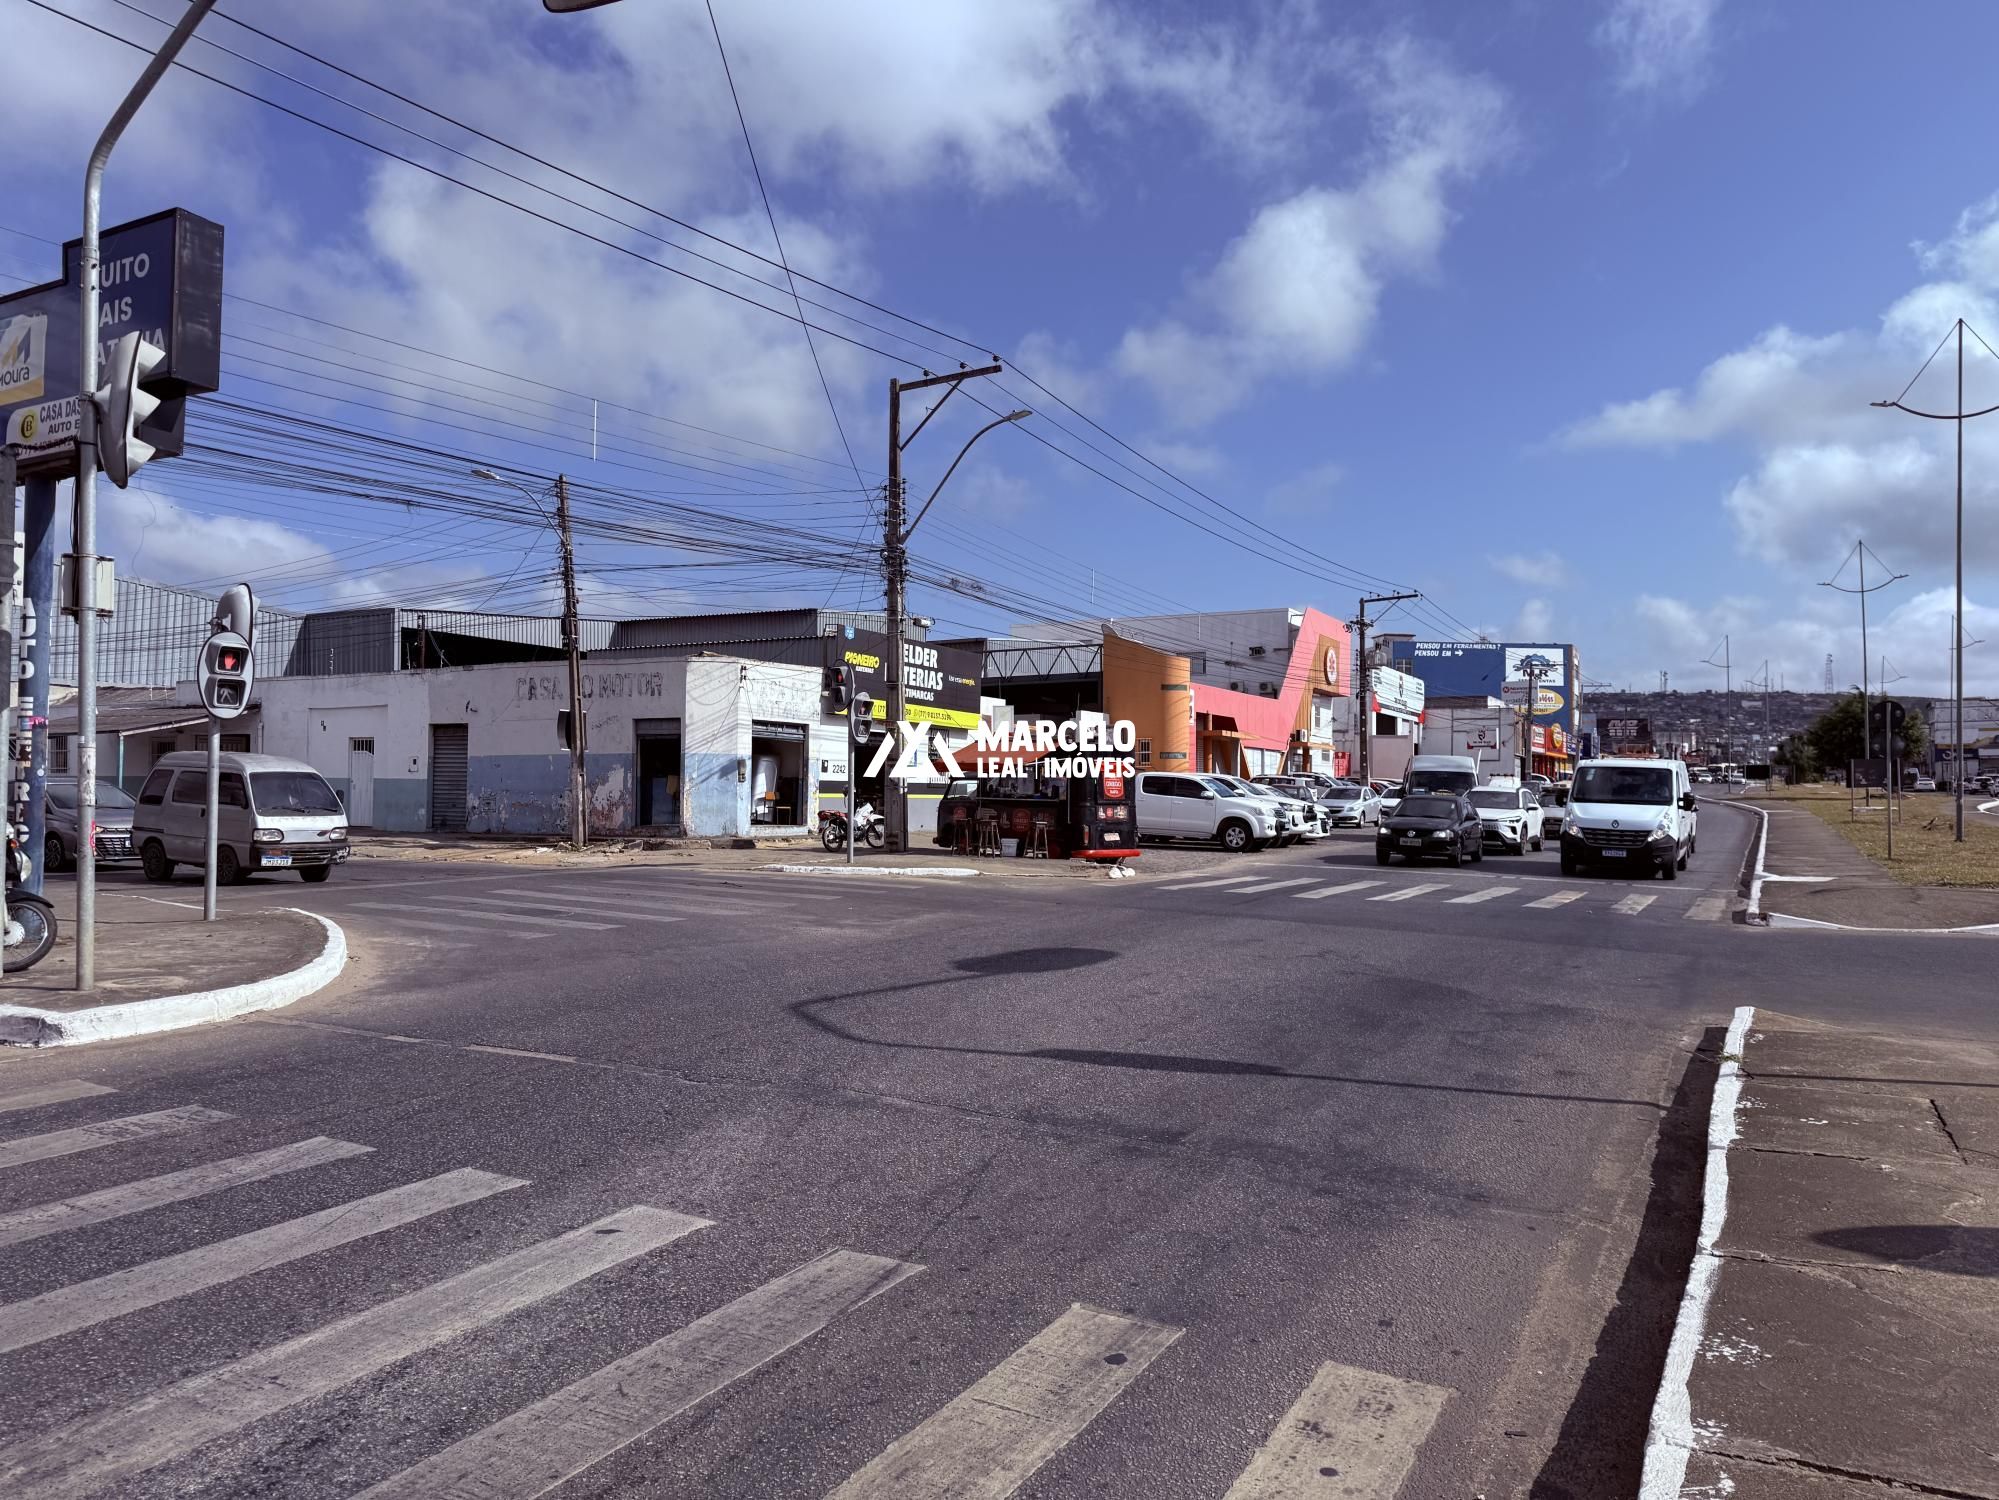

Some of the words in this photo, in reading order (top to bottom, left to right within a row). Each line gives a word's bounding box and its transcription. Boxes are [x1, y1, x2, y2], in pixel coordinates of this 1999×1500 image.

[101, 253, 150, 287] UITO
[99, 296, 132, 328] AIS
[40, 402, 63, 423] CASA
[48, 421, 71, 435] AUTO
[903, 643, 938, 668] ELDER
[884, 662, 943, 690] TERIAS
[832, 764, 846, 774] 2242
